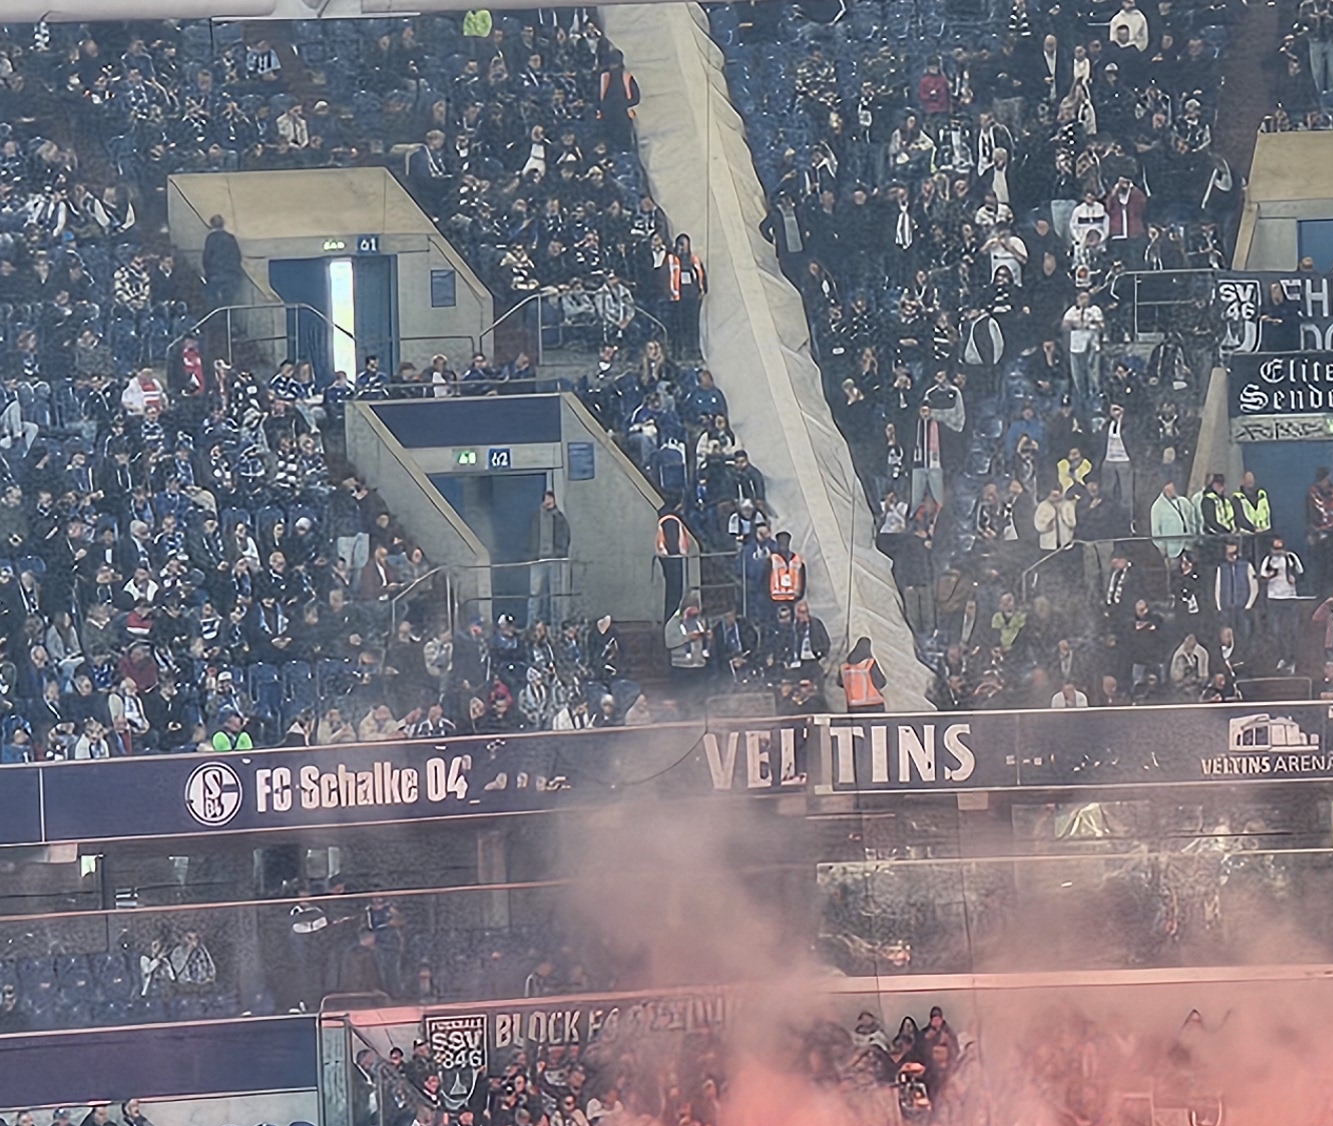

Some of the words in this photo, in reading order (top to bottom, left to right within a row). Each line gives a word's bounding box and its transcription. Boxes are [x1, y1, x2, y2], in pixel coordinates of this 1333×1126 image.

[703, 723, 977, 790] VELTINS
[1201, 754, 1271, 775] VELTINS
[256, 766, 292, 813] FC
[299, 761, 419, 810] Schalke
[425, 755, 472, 802] 04
[495, 1008, 581, 1049] BLOCK
